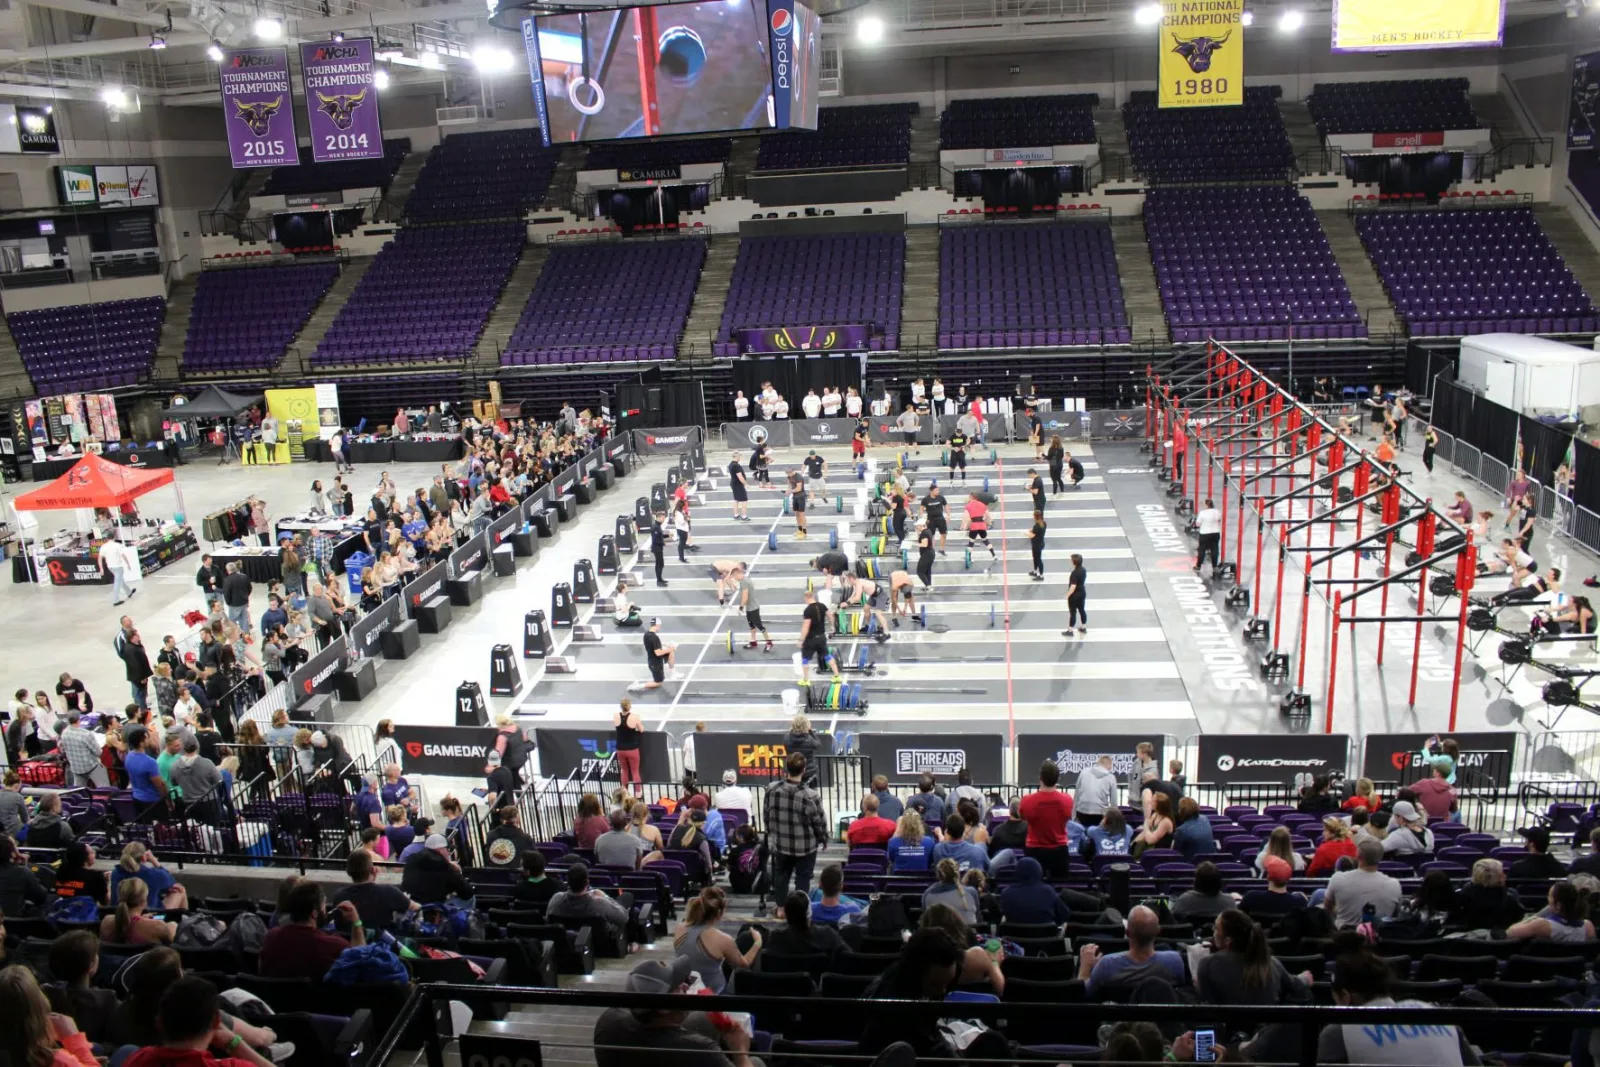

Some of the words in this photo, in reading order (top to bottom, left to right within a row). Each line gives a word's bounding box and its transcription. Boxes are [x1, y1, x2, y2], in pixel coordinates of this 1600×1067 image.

[1182, 0, 1241, 12] NATIONAL
[1162, 12, 1241, 26] CHAMPIONS
[1414, 30, 1463, 41] HOCKEY
[306, 62, 371, 76] TOURNAMENT
[775, 38, 789, 89] pepsi
[223, 70, 286, 83] TOURNAMENT
[307, 73, 373, 88] CHAMPIONS
[224, 81, 288, 95] CHAMPIONS
[1174, 78, 1228, 96] 1980
[325, 133, 368, 150] 2014
[1394, 134, 1421, 146] snell
[243, 141, 285, 157] 2015
[632, 169, 677, 180] CAMBRIA
[288, 196, 311, 205] verizon
[655, 435, 688, 444] GAMEDAY
[682, 461, 688, 469] 2
[671, 474, 677, 484] 3
[654, 491, 661, 501] 4
[639, 506, 646, 516] 5
[619, 525, 626, 536] 6
[602, 545, 609, 557] 7
[577, 570, 585, 583] 8
[556, 594, 563, 607] 9
[526, 622, 539, 636] 10
[494, 658, 505, 673] 11
[311, 657, 339, 688] GAMEDAY
[459, 697, 472, 713] 12
[423, 744, 487, 758] GAMEDAY
[900, 752, 912, 771] WOD
[915, 752, 963, 765] THREADS
